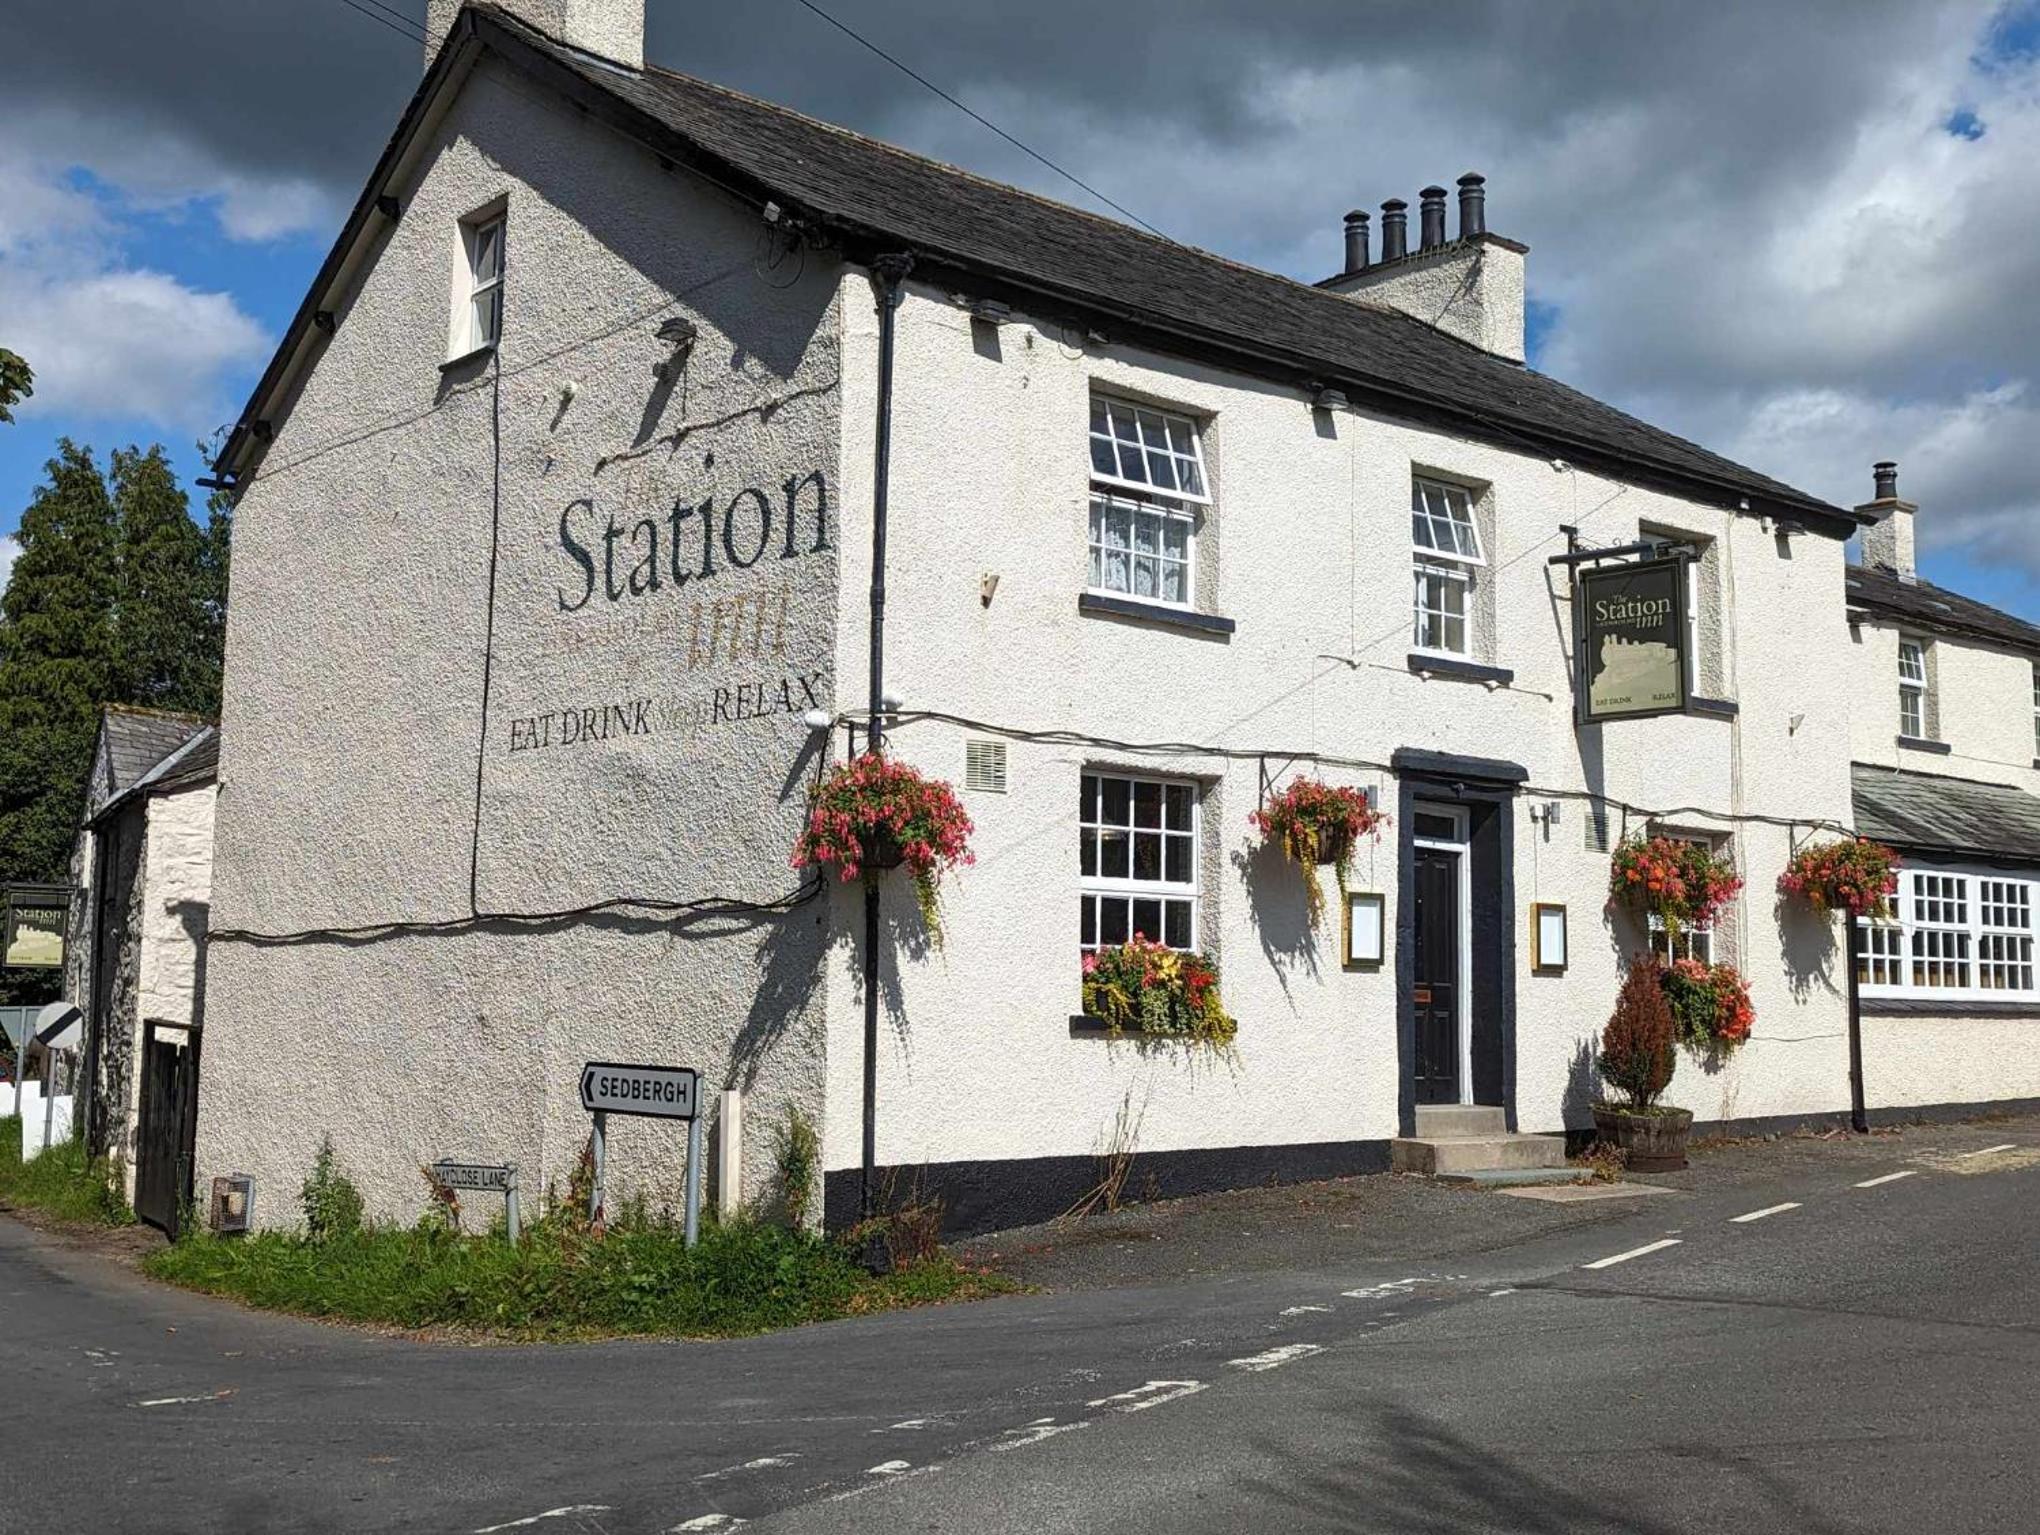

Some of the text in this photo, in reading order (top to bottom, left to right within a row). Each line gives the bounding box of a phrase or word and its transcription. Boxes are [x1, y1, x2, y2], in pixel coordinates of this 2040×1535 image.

[558, 452, 836, 612] Station
[1595, 595, 1672, 622] Station
[1636, 614, 1663, 628] inn
[510, 714, 555, 751] EAT
[561, 700, 652, 746] DRINK
[711, 672, 825, 724] RELAX
[600, 1076, 687, 1104] SEDBERGH
[482, 1169, 507, 1188] LANE
